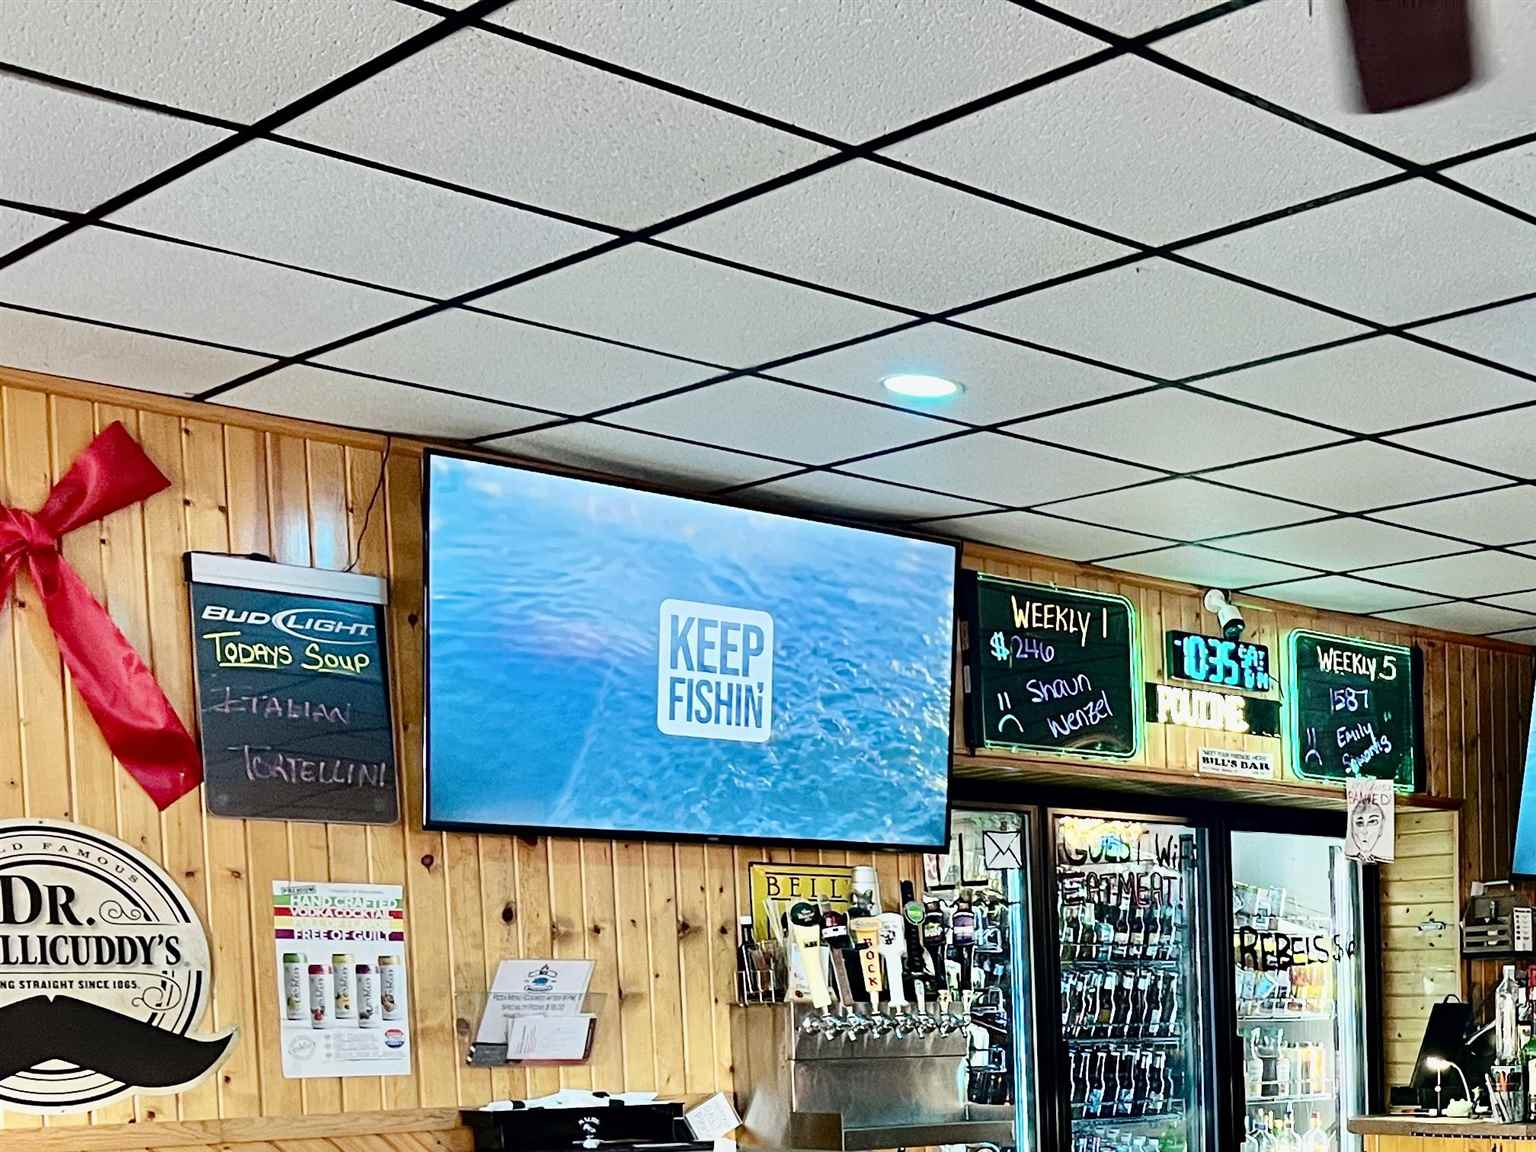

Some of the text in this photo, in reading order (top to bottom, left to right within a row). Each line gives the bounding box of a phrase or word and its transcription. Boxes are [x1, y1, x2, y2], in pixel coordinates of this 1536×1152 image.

[201, 605, 376, 636] BUD LIGHT
[1011, 595, 1108, 647] WEEKLY 1
[670, 614, 765, 677] KEEP
[1317, 645, 1398, 682] WEEKLY 5
[669, 676, 764, 729] FISHIN'
[1026, 673, 1092, 703] Shaun
[1330, 687, 1369, 714] 1587
[43, 843, 139, 883] FAMOUS
[0, 875, 96, 926] DR.
[295, 929, 329, 941] FREE
[19, 979, 74, 989] STRAIGHT
[78, 979, 110, 989] SINCE
